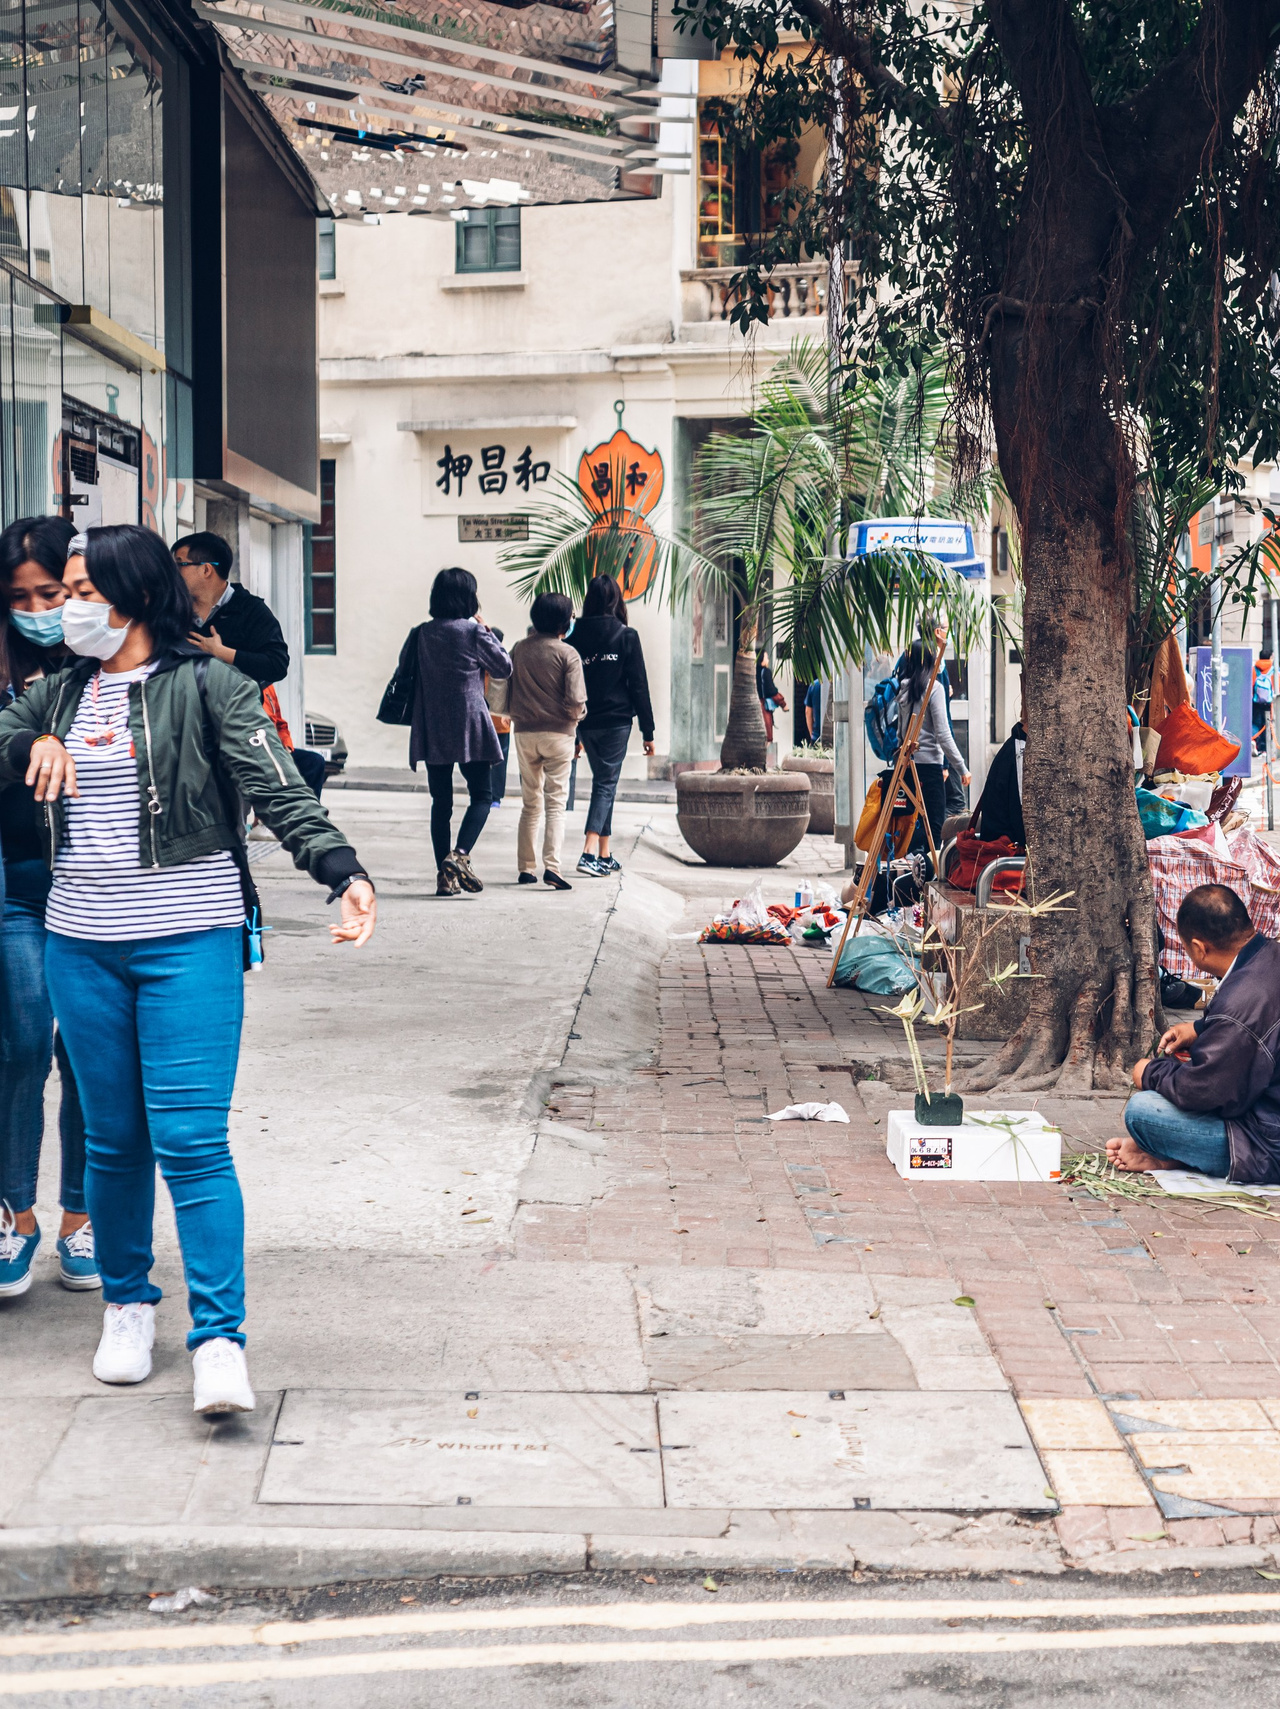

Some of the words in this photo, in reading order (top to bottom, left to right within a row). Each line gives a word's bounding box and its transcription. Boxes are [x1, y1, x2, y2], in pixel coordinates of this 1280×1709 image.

[462, 518, 471, 526] Tai
[473, 518, 489, 526] Wong
[490, 517, 509, 525] Street
[892, 535, 929, 544] PCCW
[436, 1442, 504, 1451] Wharf
[511, 1443, 550, 1452] T&T
